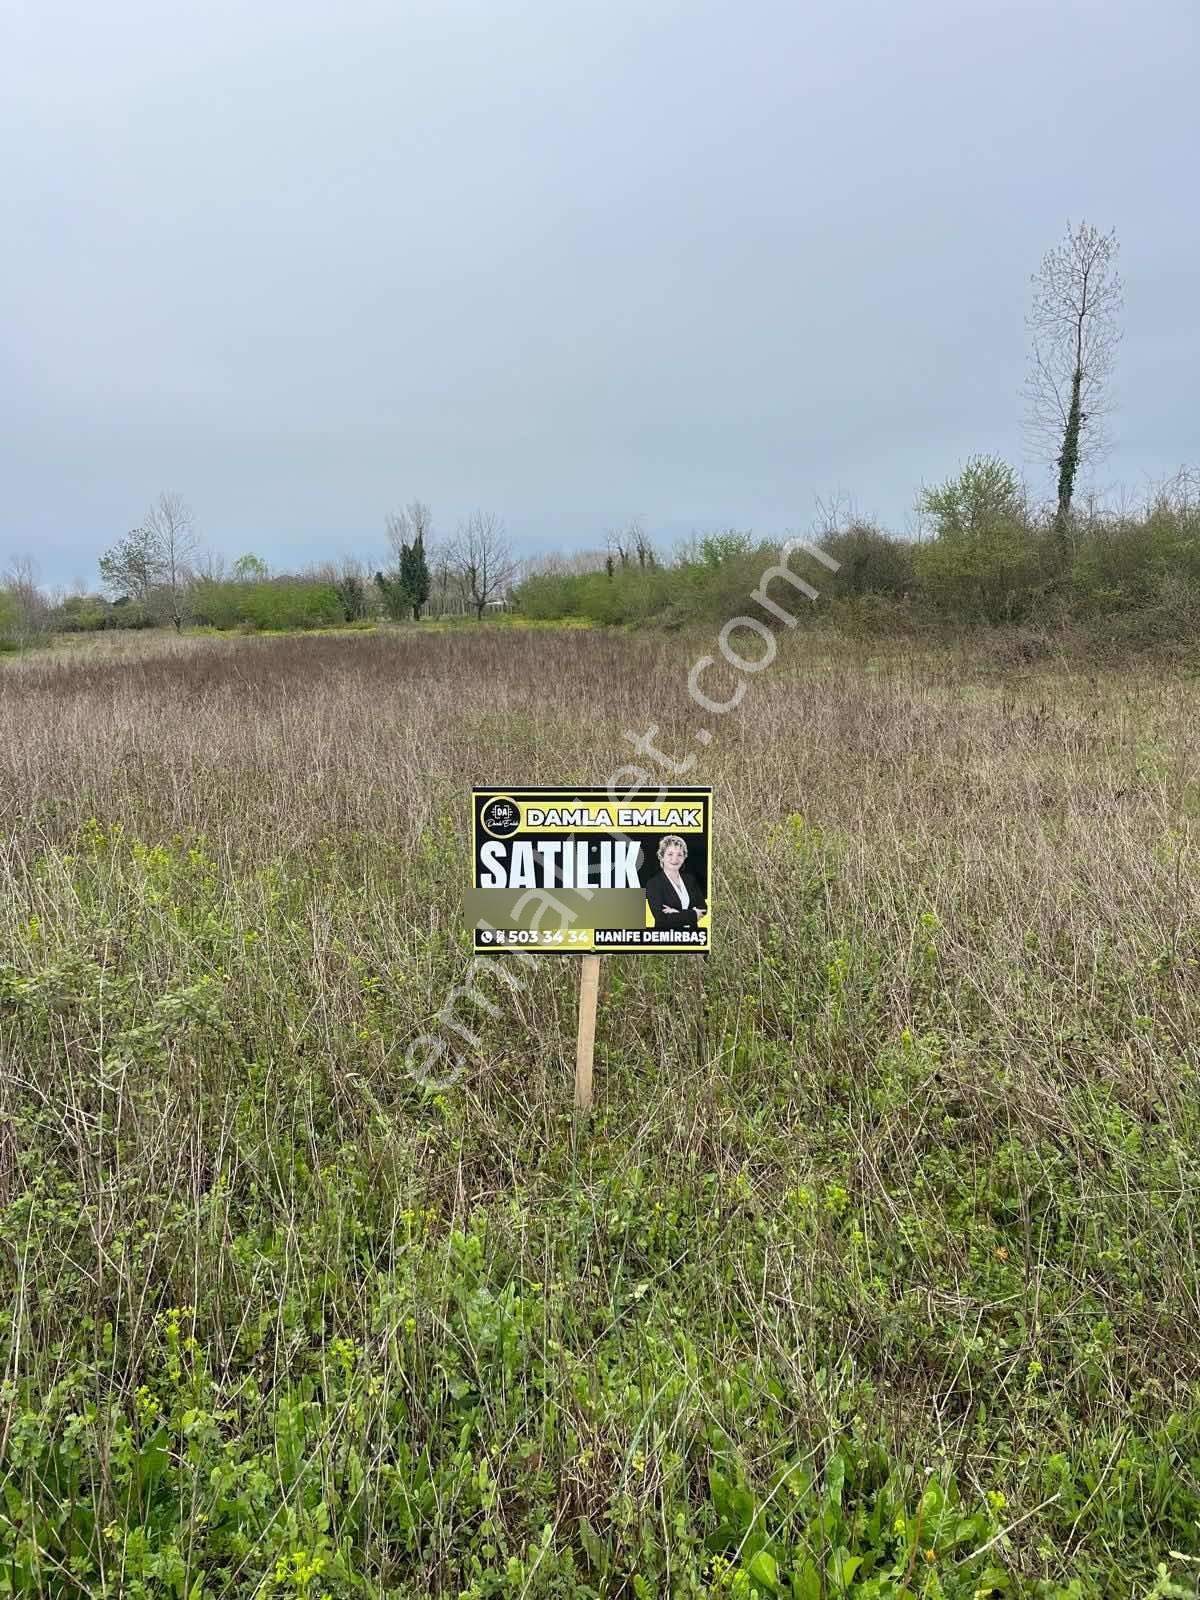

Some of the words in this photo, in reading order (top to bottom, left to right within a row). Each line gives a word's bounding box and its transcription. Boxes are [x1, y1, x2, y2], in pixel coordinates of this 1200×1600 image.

[496, 807, 508, 817] DA
[526, 808, 614, 827] DAMLA
[617, 808, 702, 827] EMLAK
[480, 840, 642, 889] SATILIK
[508, 930, 539, 944] 503
[542, 930, 564, 944] 34
[567, 930, 589, 944] 34
[595, 929, 641, 943] HANİFE
[643, 929, 707, 946] DEMİRBAŞ
